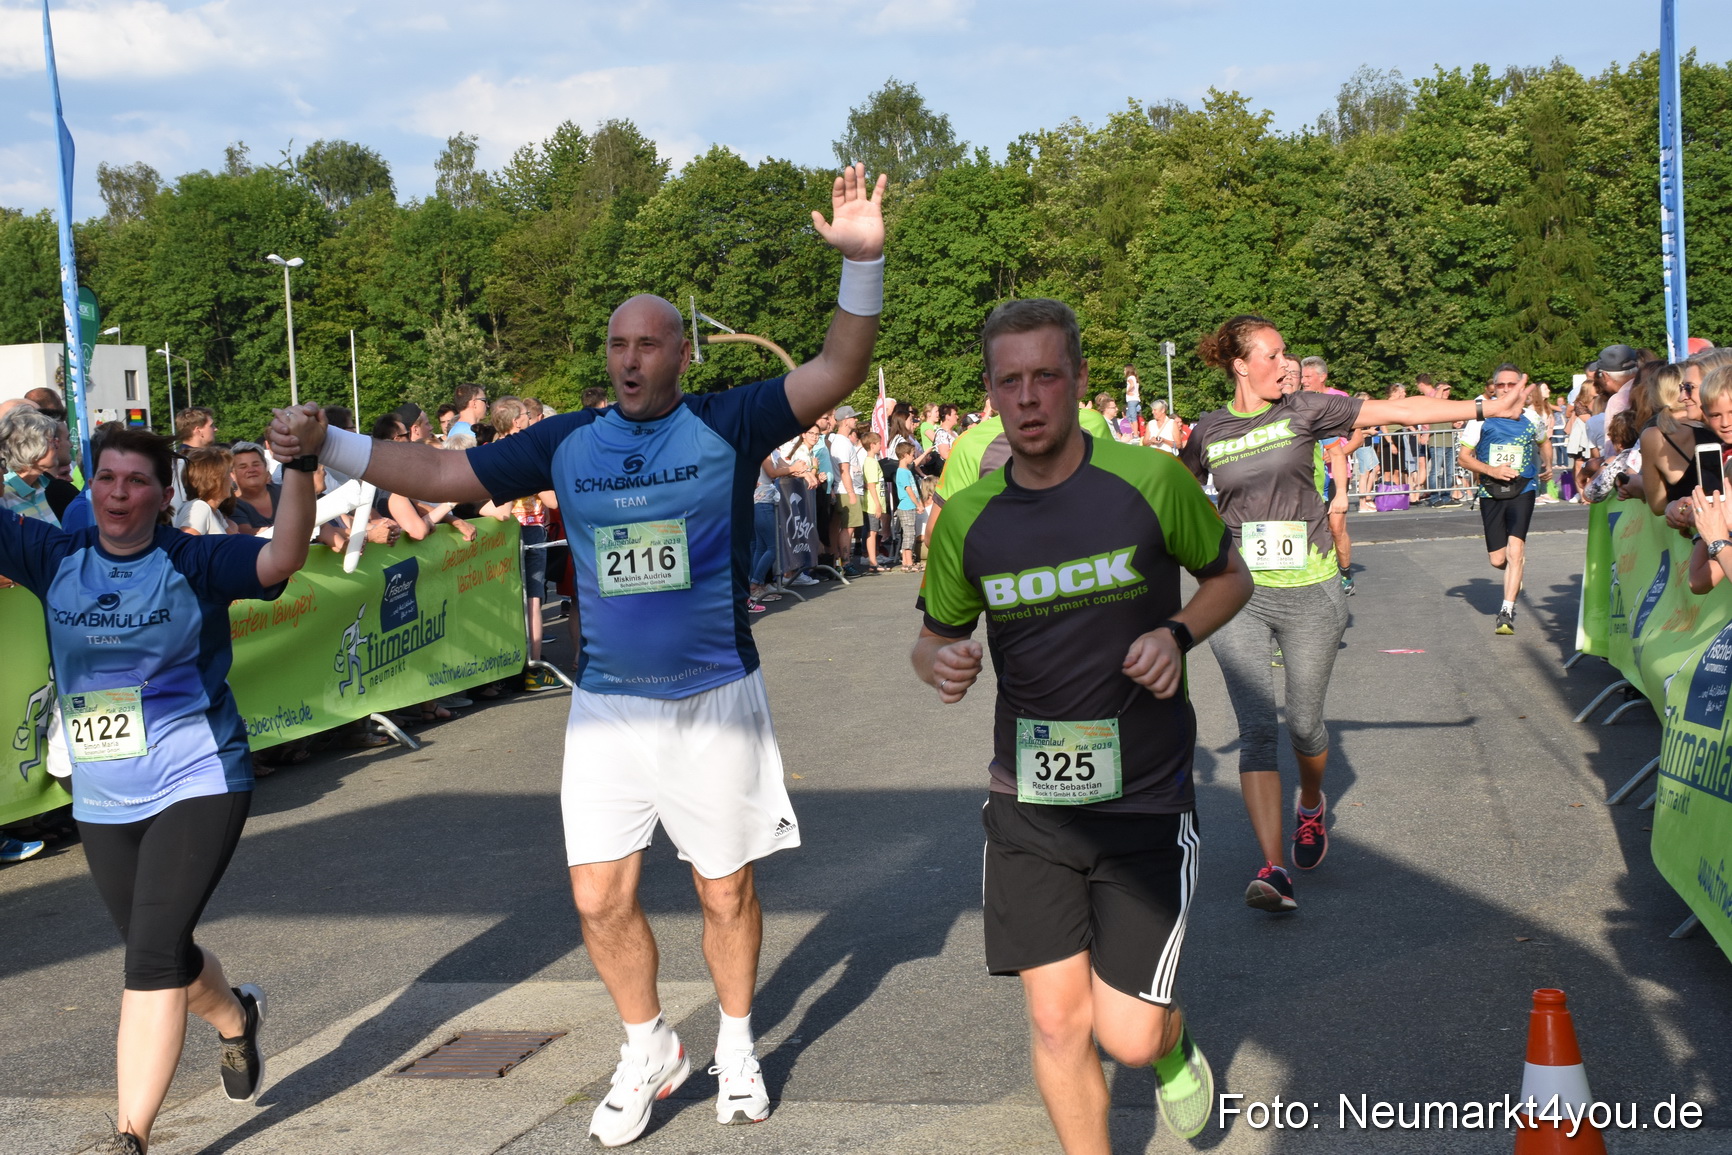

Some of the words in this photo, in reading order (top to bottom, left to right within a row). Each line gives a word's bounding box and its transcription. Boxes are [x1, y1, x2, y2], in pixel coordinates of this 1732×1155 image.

[1207, 420, 1292, 460] BOCK
[1240, 448, 1261, 458] smart
[1261, 440, 1292, 452] concepts
[1496, 453, 1516, 463] 248
[614, 495, 648, 509] TEAM
[606, 545, 677, 577] 2116
[613, 574, 642, 584] Miskinis
[643, 571, 672, 581] Audrius
[982, 550, 1140, 608] BOCK
[271, 584, 318, 629] länger!
[991, 608, 1032, 624] inspired
[1034, 605, 1050, 617] by
[1052, 597, 1091, 613] smart
[1093, 584, 1149, 605] concepts
[52, 607, 172, 630] SCHABMÜLLER
[86, 635, 121, 645] TEAM
[367, 598, 448, 672] firmenlauf
[369, 660, 407, 688] neumarkt
[602, 662, 720, 684] www.schabmueller.de
[118, 705, 136, 713] 2019
[71, 713, 131, 743] 2122
[1091, 741, 1113, 750] 2019
[1034, 751, 1096, 782] 325
[1032, 781, 1058, 791] Recker
[1059, 781, 1102, 791] Sebastian
